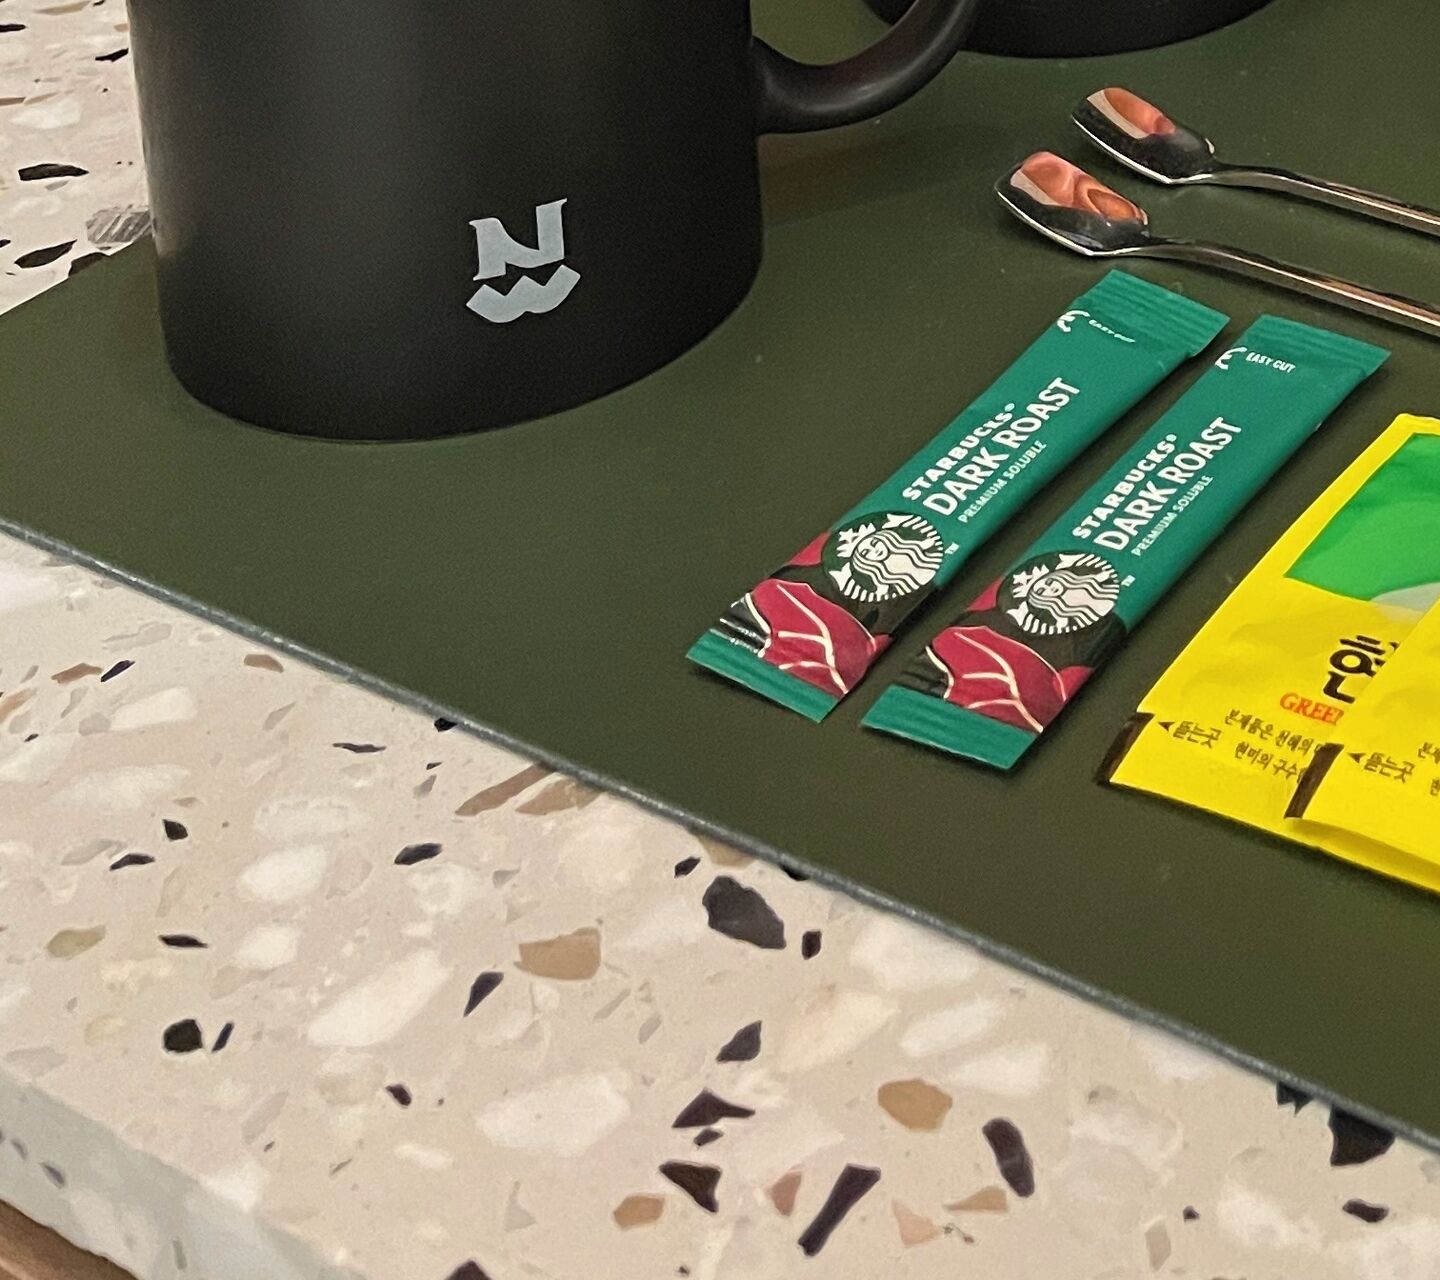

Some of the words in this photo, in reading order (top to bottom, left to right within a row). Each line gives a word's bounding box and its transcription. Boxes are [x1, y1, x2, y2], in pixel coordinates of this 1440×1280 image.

[1273, 359, 1296, 373] CUT
[922, 446, 1010, 516] DARK
[991, 377, 1081, 449] ROAST
[958, 478, 1008, 523] PREMIUM
[1003, 440, 1047, 480] SOLUBLE
[1093, 481, 1179, 551] DARK
[1157, 416, 1242, 485] ROAST
[1131, 511, 1177, 557] PREMIUM
[1172, 475, 1214, 513] SOLUBLE
